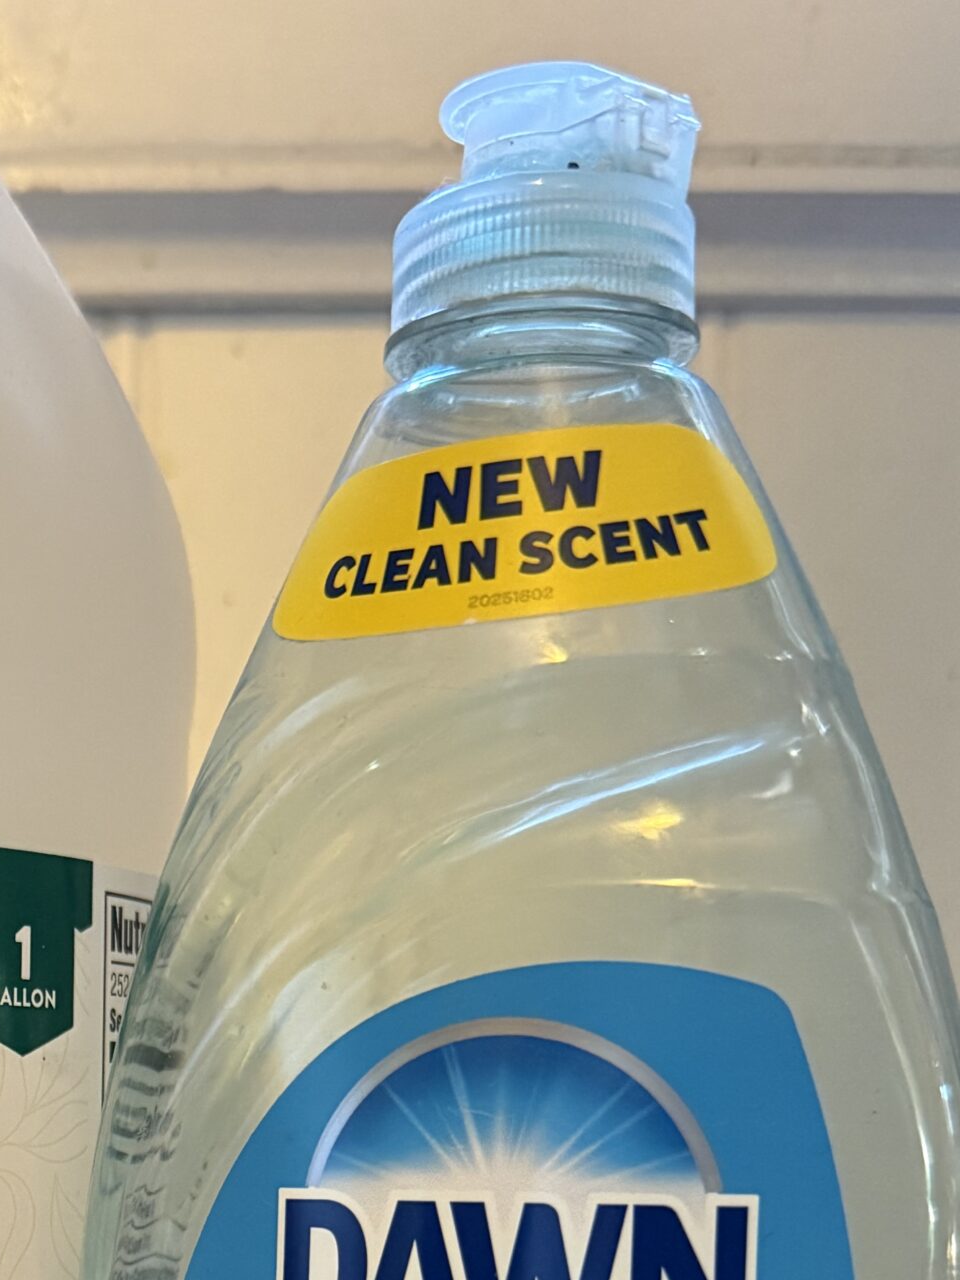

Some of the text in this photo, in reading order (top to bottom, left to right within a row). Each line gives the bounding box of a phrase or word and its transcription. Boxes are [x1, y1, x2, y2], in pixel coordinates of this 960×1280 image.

[417, 449, 602, 530] NEW
[324, 508, 710, 599] CLEAN SCENT
[14, 925, 32, 981] 1
